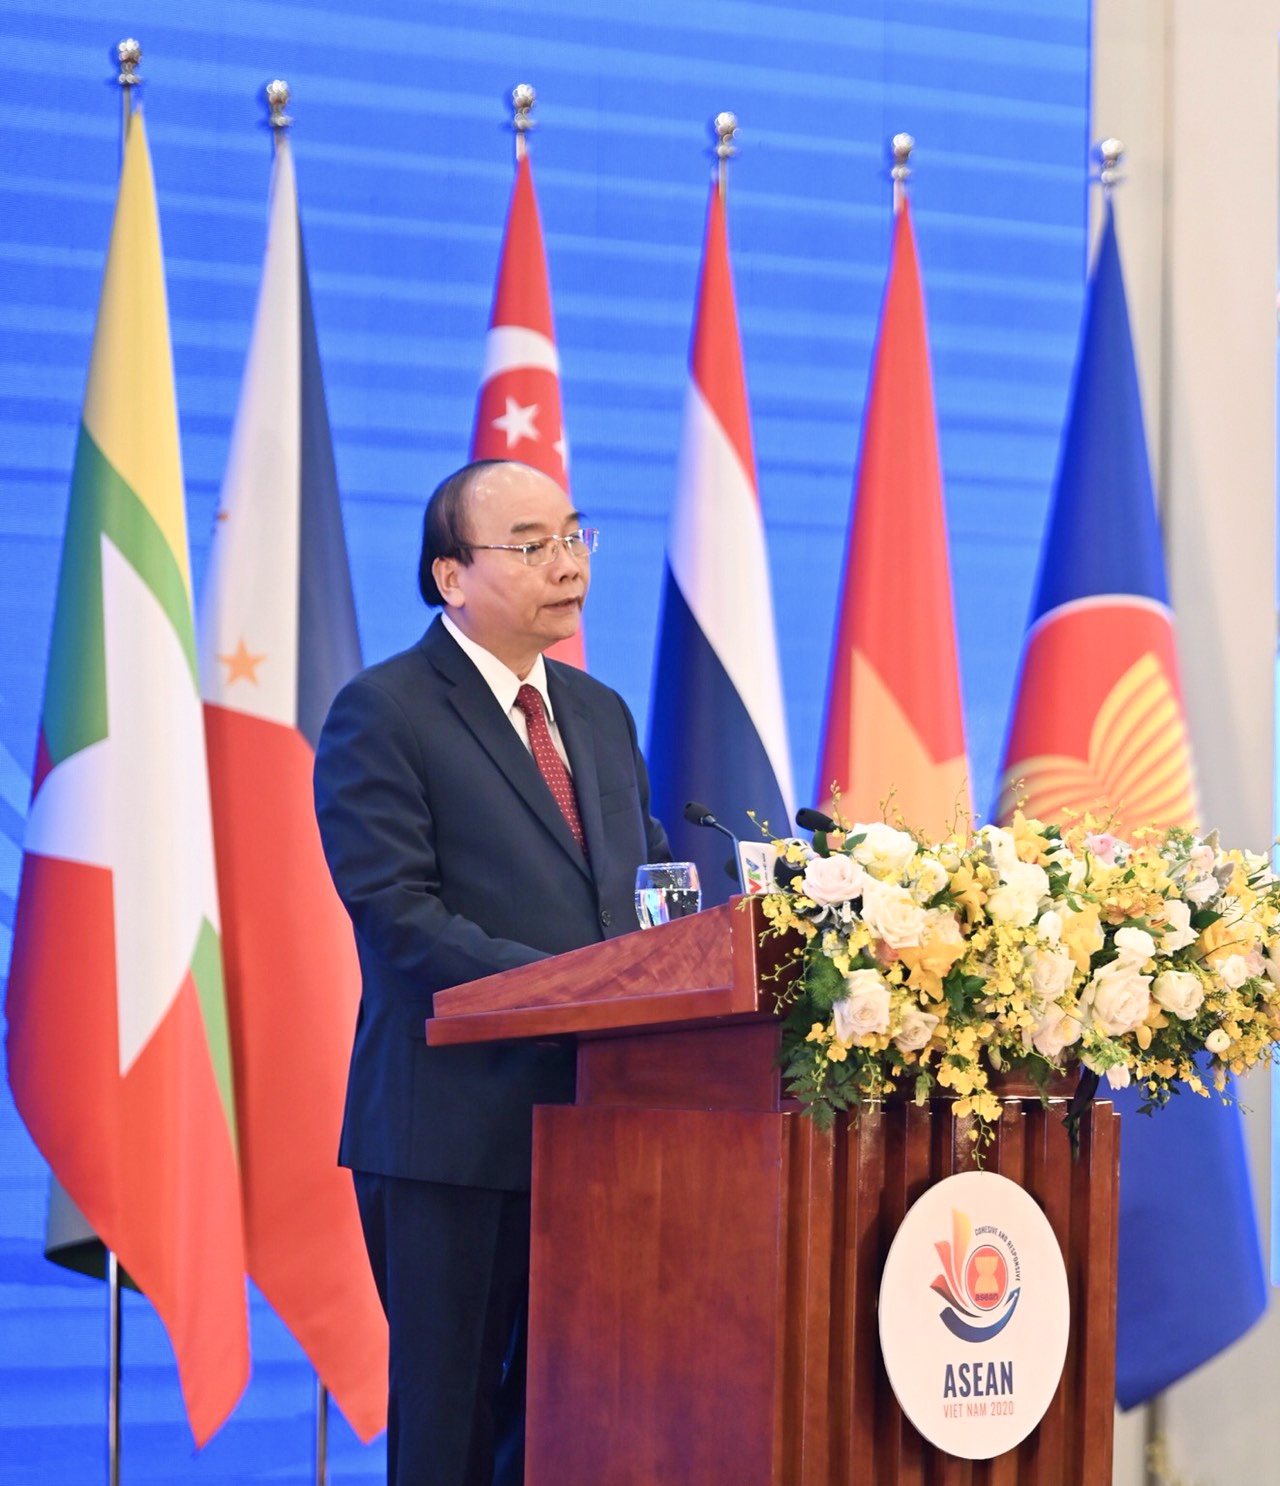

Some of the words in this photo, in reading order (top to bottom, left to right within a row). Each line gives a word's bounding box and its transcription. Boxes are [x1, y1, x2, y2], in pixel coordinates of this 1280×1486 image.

[998, 1230, 1008, 1242] AND
[943, 1361, 1014, 1398] ASEAN
[943, 1403, 963, 1418] VIET
[966, 1402, 987, 1418] NAM
[990, 1400, 1015, 1416] 2020
